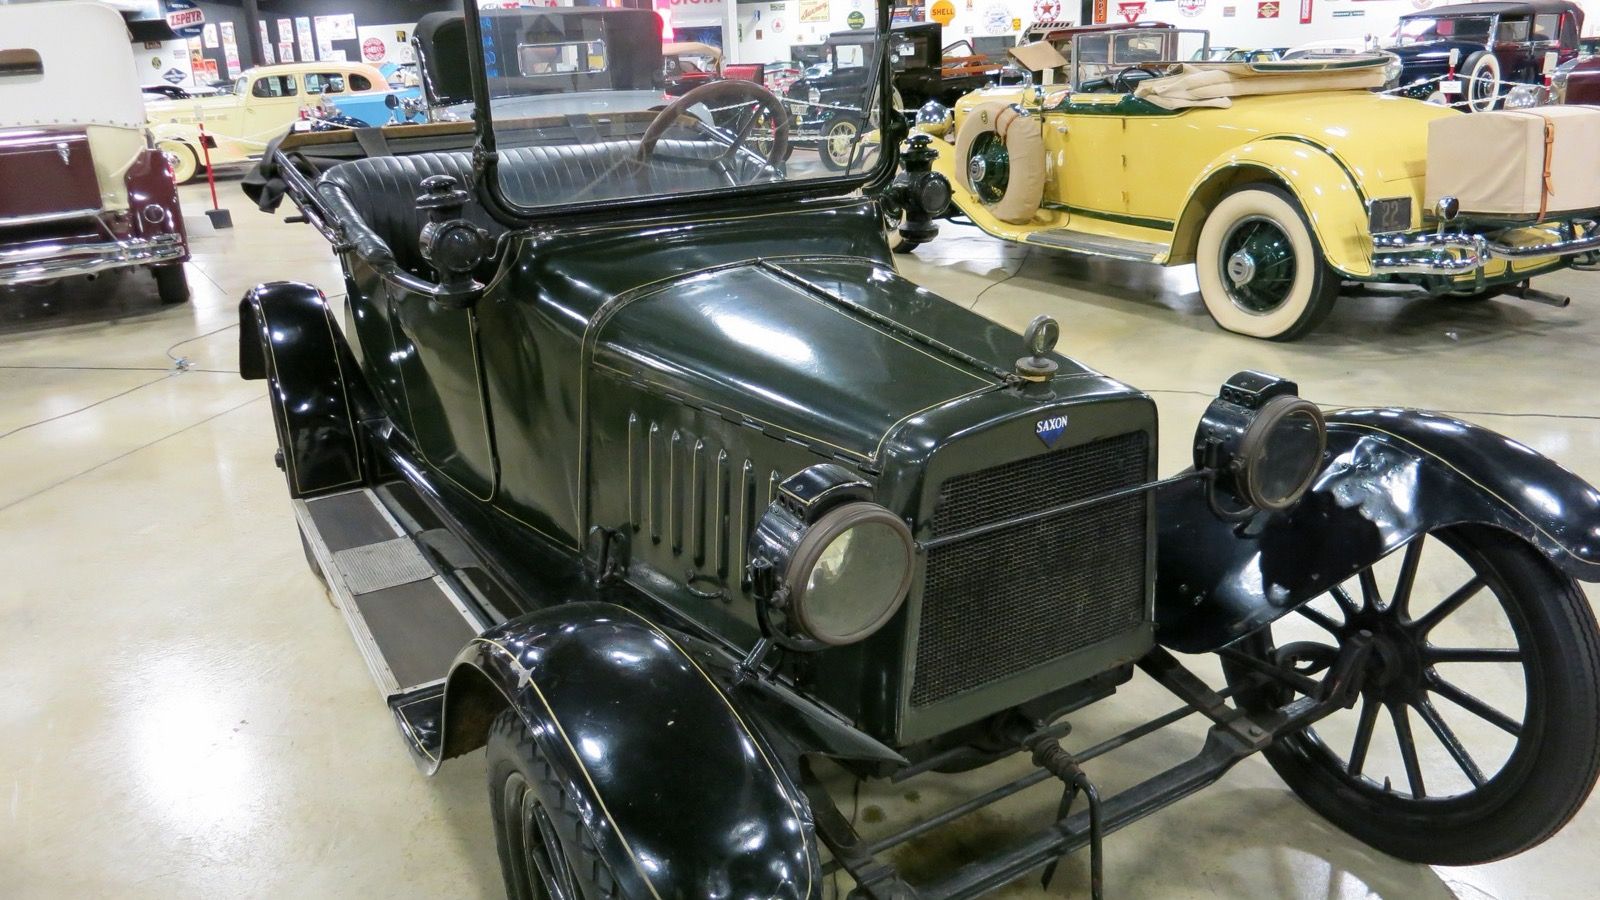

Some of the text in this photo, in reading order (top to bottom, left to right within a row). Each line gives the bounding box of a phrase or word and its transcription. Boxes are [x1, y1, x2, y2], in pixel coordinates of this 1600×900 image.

[170, 10, 202, 26] ZEPHYR
[932, 8, 954, 16] SHELL
[1382, 200, 1400, 227] 22
[1036, 415, 1068, 433] SAXON
